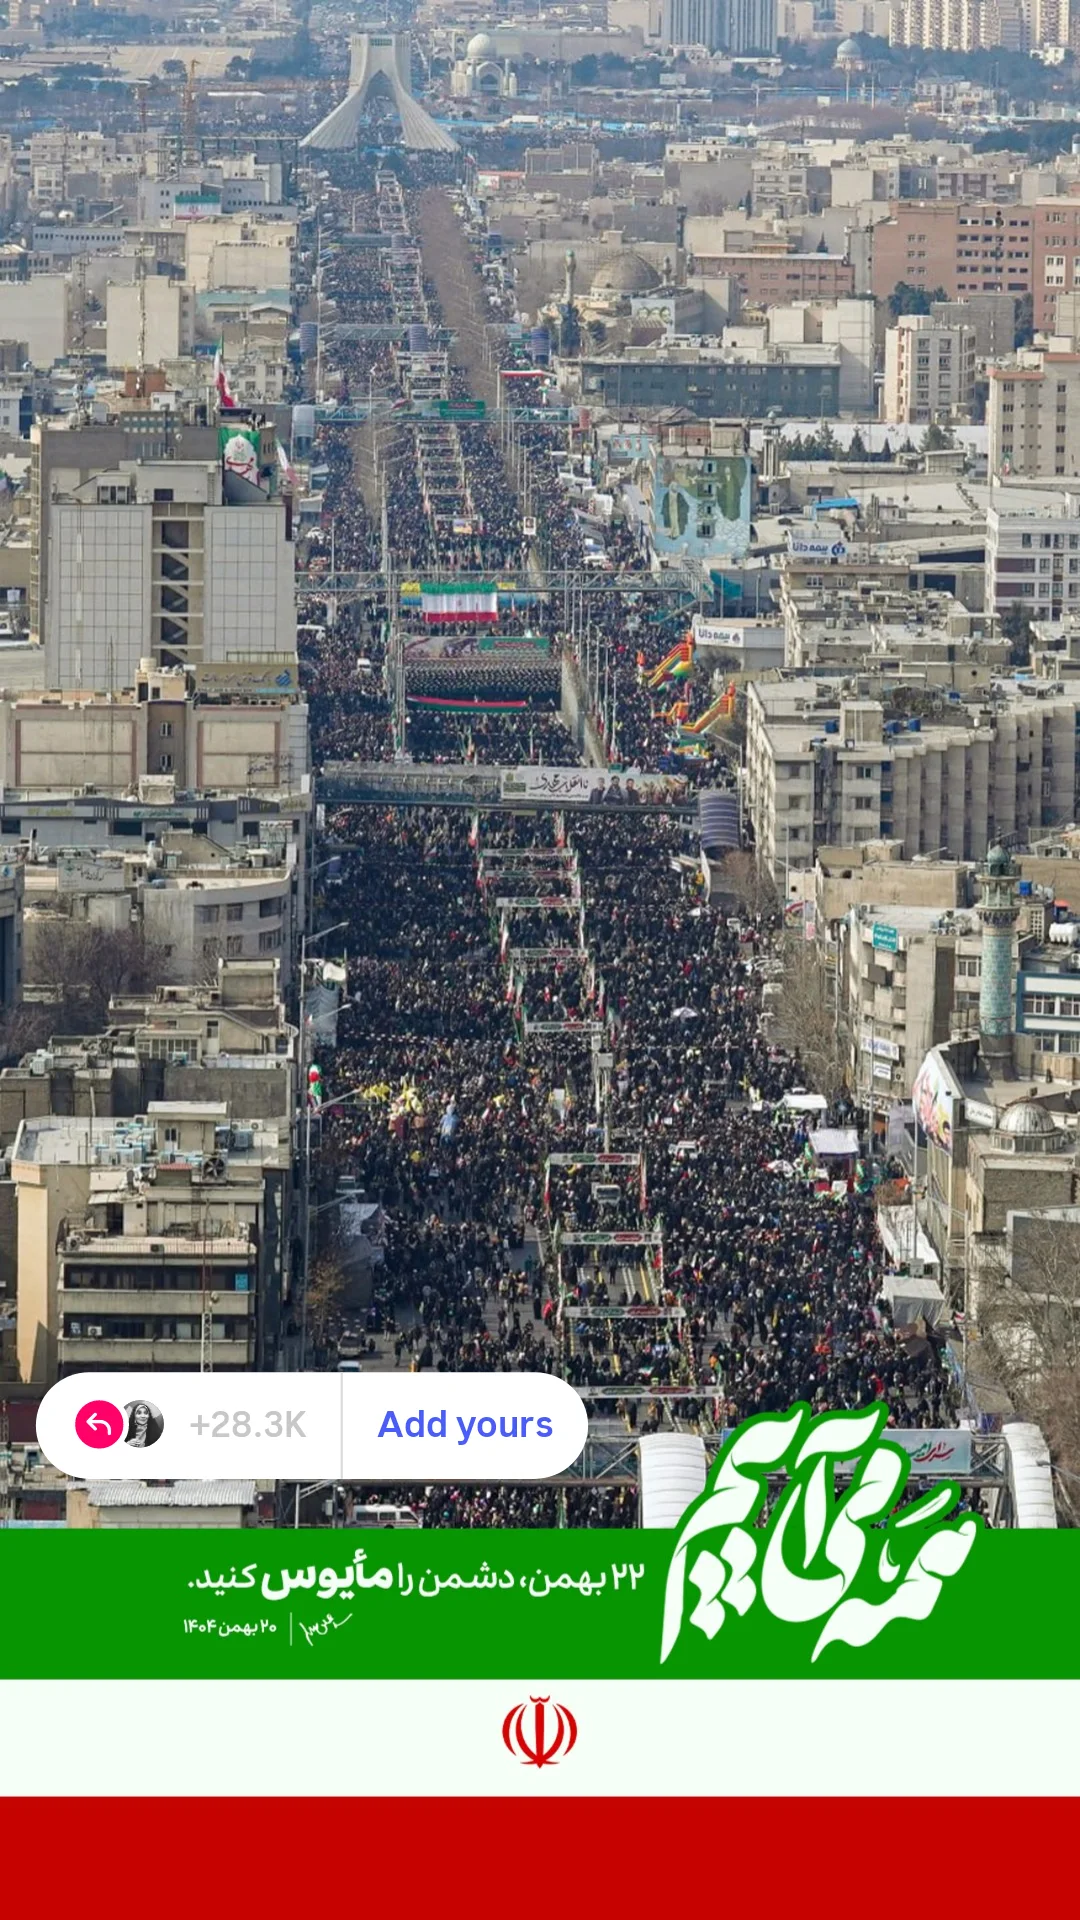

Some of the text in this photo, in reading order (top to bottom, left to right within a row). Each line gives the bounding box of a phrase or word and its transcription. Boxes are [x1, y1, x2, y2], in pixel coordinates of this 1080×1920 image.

[792, 542, 828, 555] بیمه دانا
[698, 628, 730, 643] بیمه دانا
